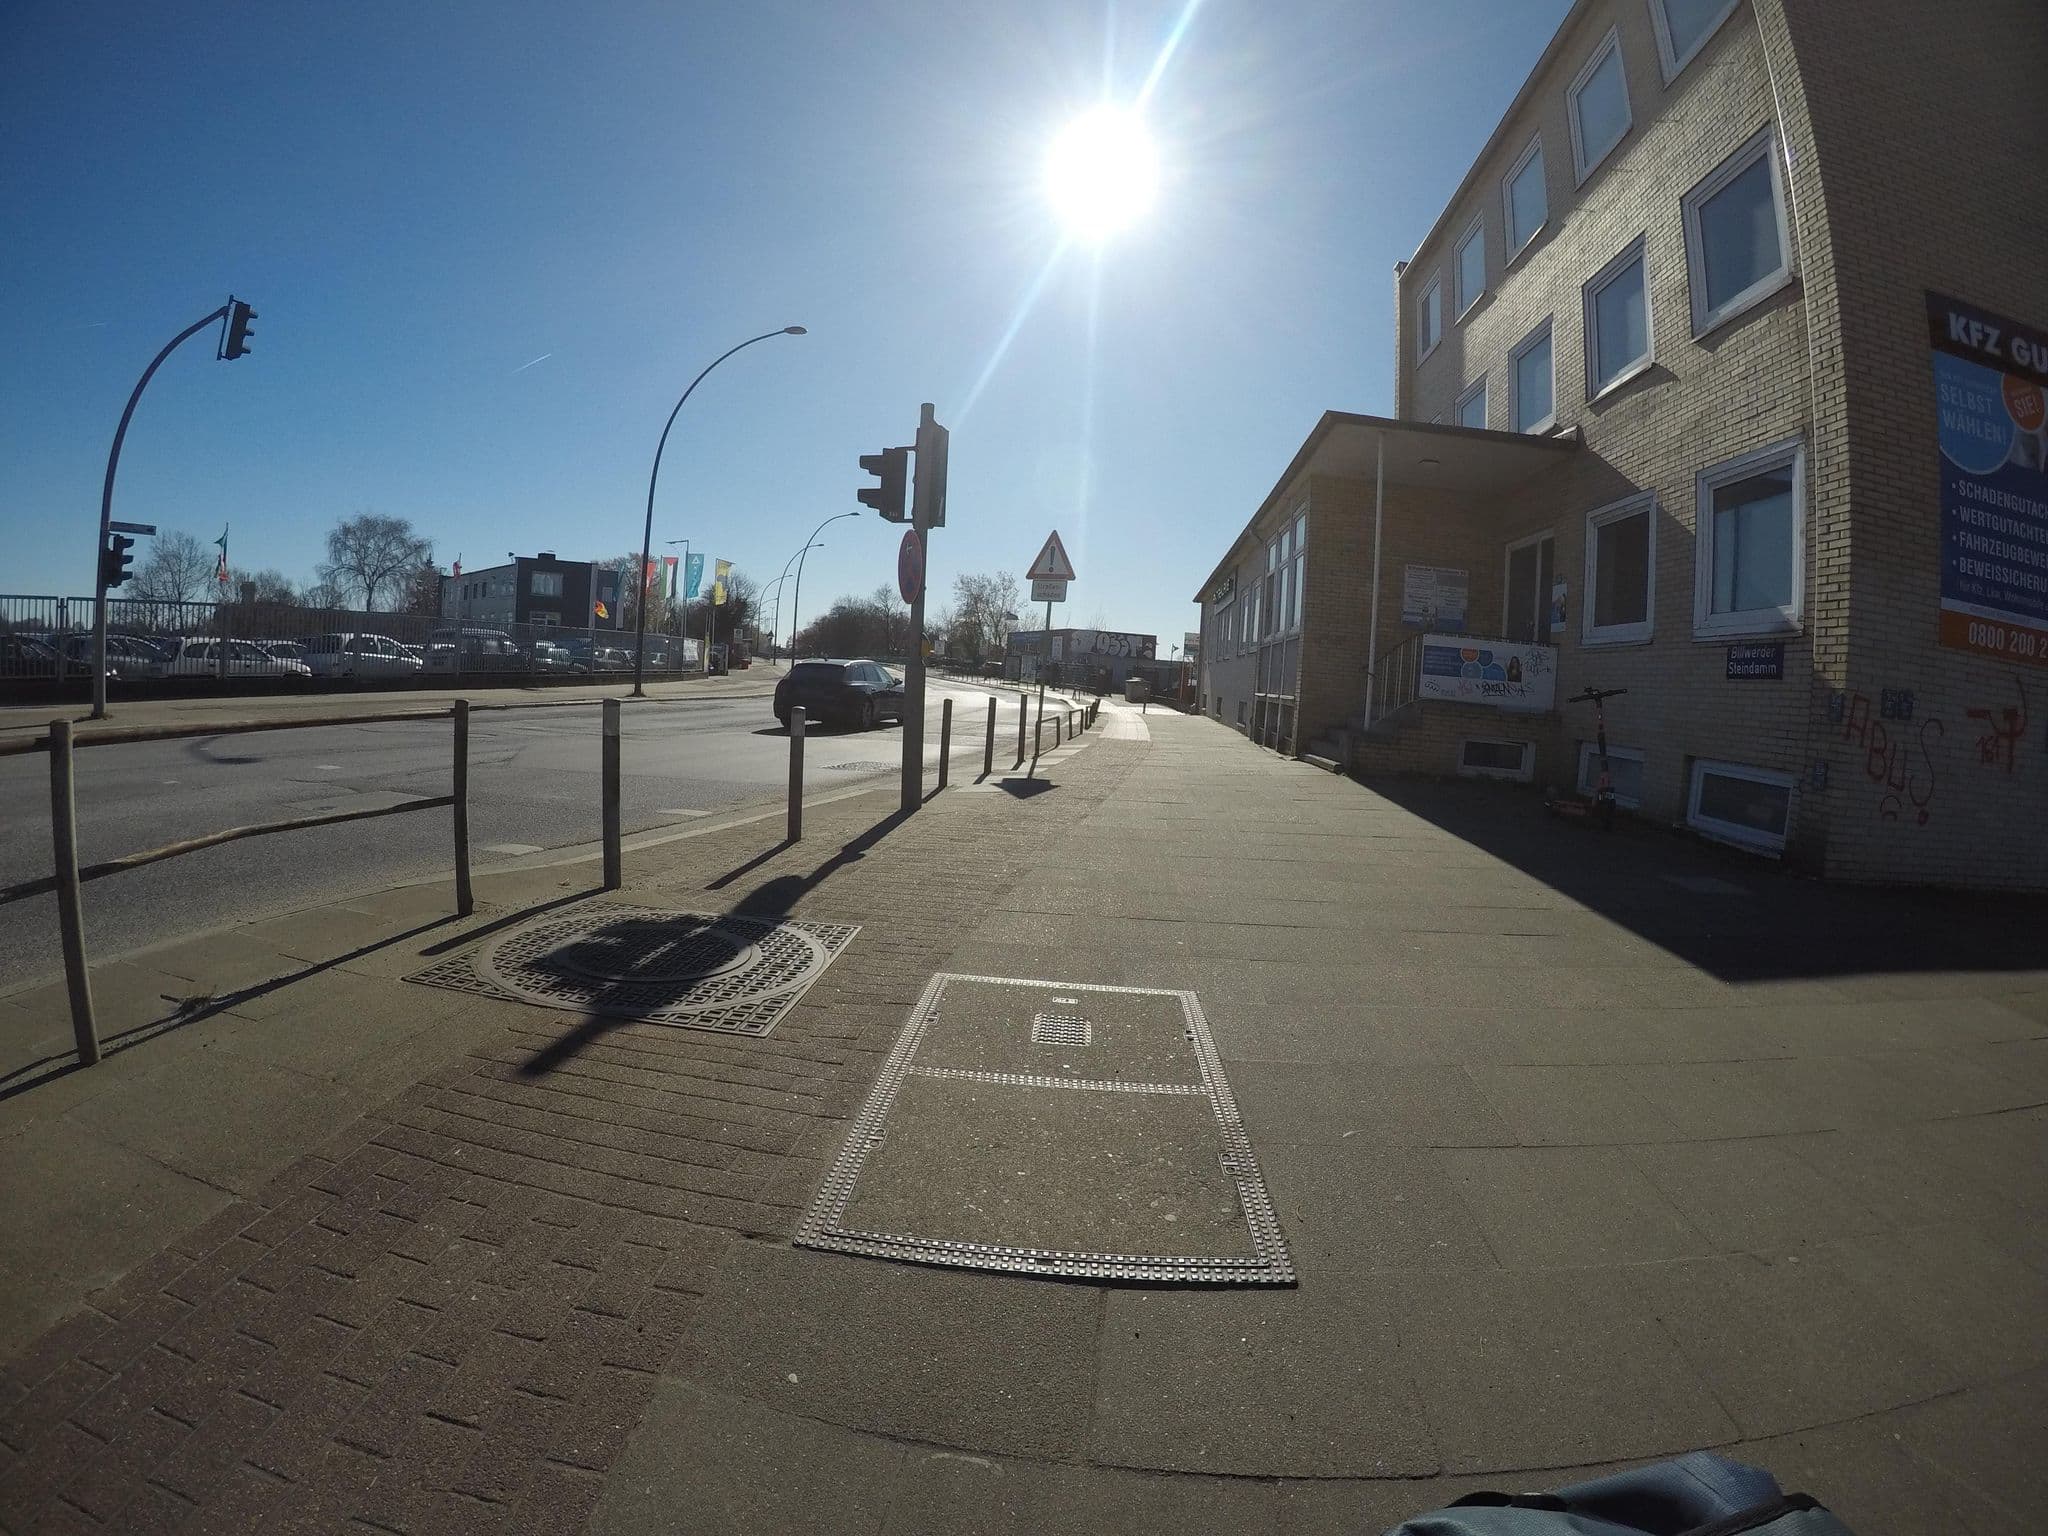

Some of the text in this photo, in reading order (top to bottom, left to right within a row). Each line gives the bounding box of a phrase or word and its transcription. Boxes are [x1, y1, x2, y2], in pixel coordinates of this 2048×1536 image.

[1948, 311, 2001, 357] KFZ
[1940, 383, 1993, 415] SELBST
[1959, 506, 2048, 545] WERTGUTACHTE
[1959, 531, 2048, 569] FAHRZEUGBEWE
[1730, 646, 1777, 659] Billwerder
[1968, 622, 2005, 650] 0800
[2009, 631, 2035, 657] 200
[1728, 662, 1777, 675] Steindamm
